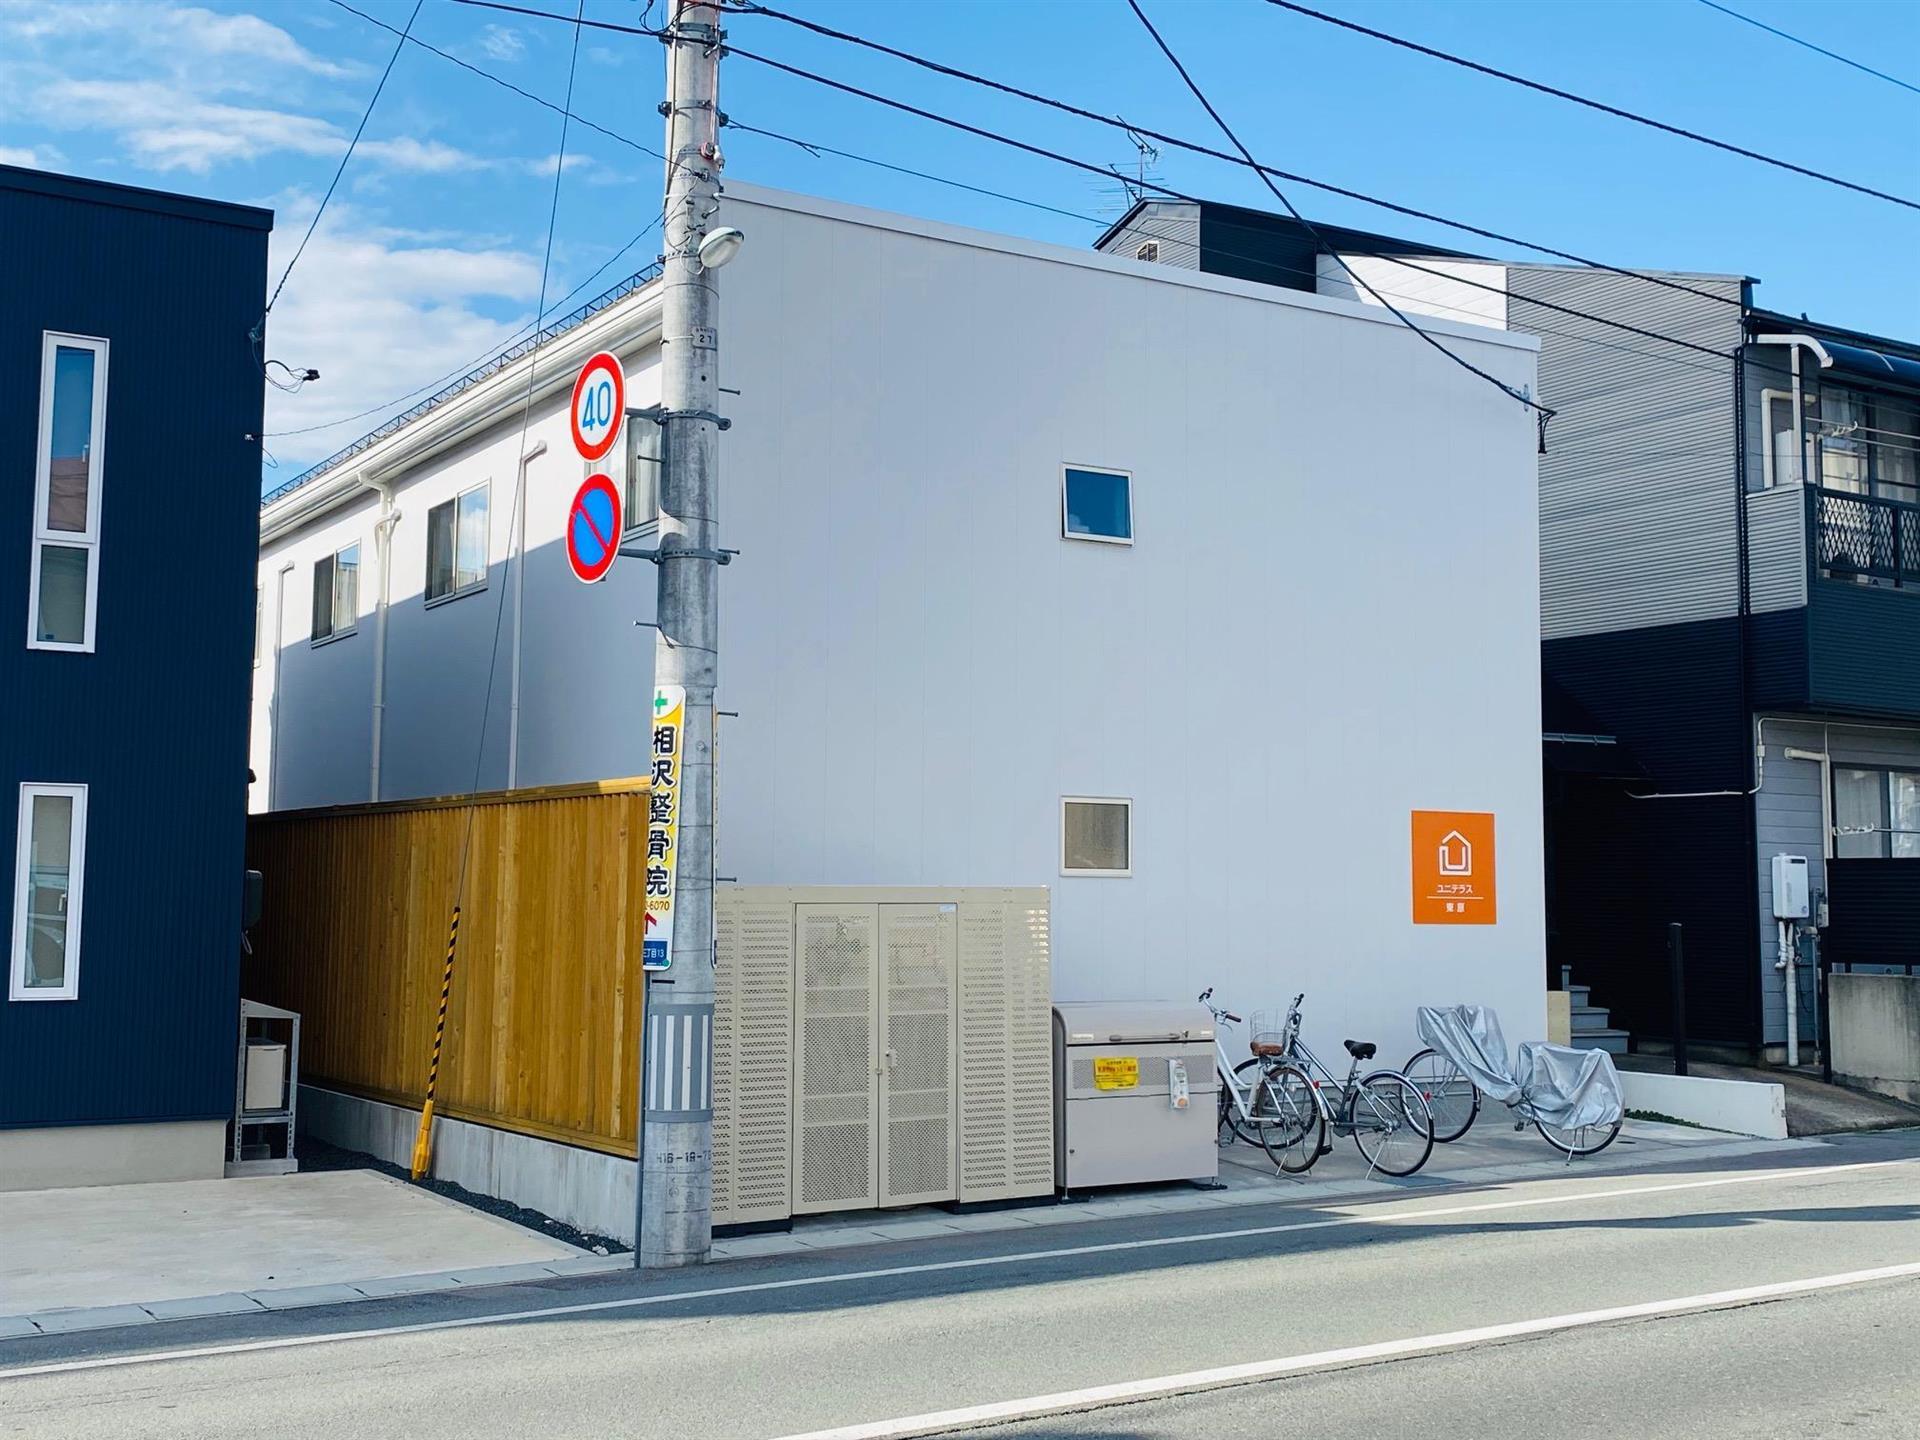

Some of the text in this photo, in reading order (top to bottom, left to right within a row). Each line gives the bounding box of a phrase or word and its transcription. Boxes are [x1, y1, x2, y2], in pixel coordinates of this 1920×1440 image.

[582, 381, 611, 432] 40
[646, 725, 676, 894] 相沢整骨院
[1436, 884, 1473, 894] ユニテラス
